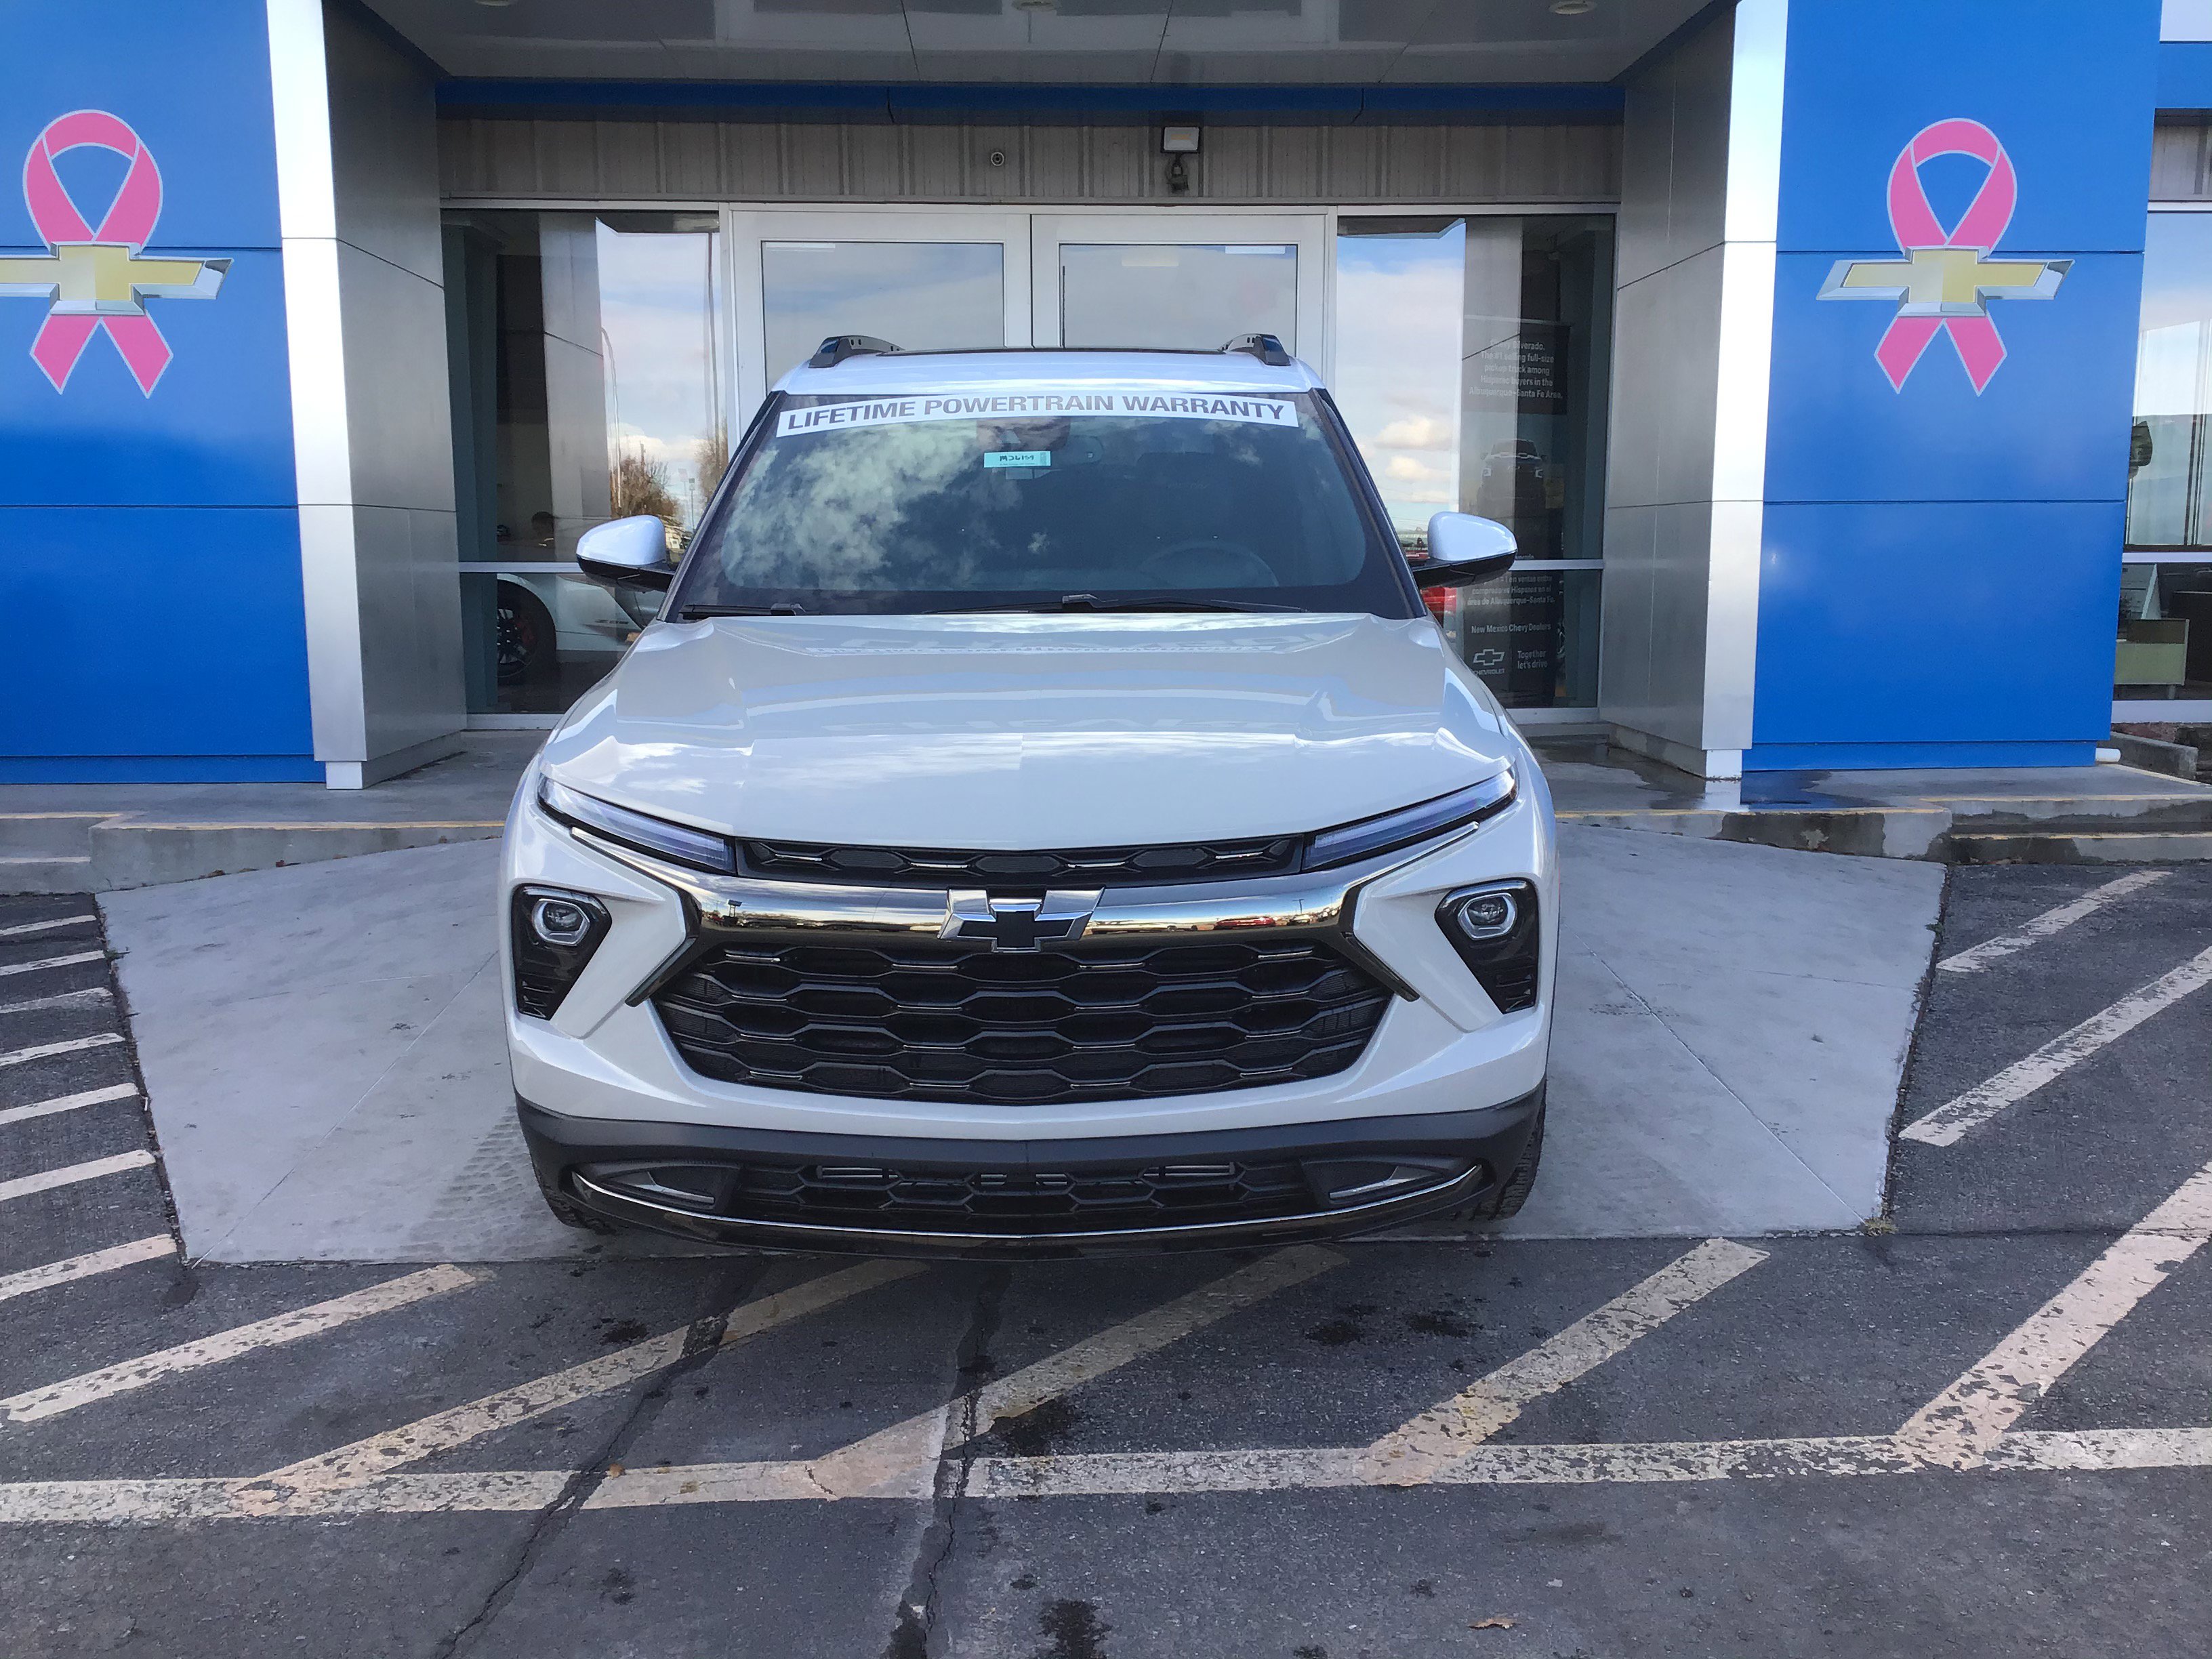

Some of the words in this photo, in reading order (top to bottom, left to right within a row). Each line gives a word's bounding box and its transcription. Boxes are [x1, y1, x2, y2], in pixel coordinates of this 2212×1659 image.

[1481, 351, 1494, 359] The
[1527, 353, 1555, 363] full-size
[1484, 363, 1507, 373] pickup
[1509, 365, 1526, 373] truck
[1527, 367, 1551, 376] among
[1480, 375, 1510, 386] Hispanic
[1511, 376, 1534, 387] buyers
[1534, 377, 1541, 386] in
[1542, 378, 1553, 387] the
[1536, 390, 1545, 398] Fe
[787, 401, 916, 430] LIFETIME
[924, 395, 1114, 415] POWERTRAIN
[1122, 396, 1284, 420] WARRANTY
[1481, 597, 1490, 605] de
[1471, 625, 1486, 634] New
[1486, 624, 1508, 633] Mexico
[1509, 623, 1528, 633] Chevy
[1529, 623, 1551, 631] Dealers
[1517, 649, 1546, 660] Together
[1517, 660, 1531, 670] let's
[1532, 660, 1548, 668] drive
